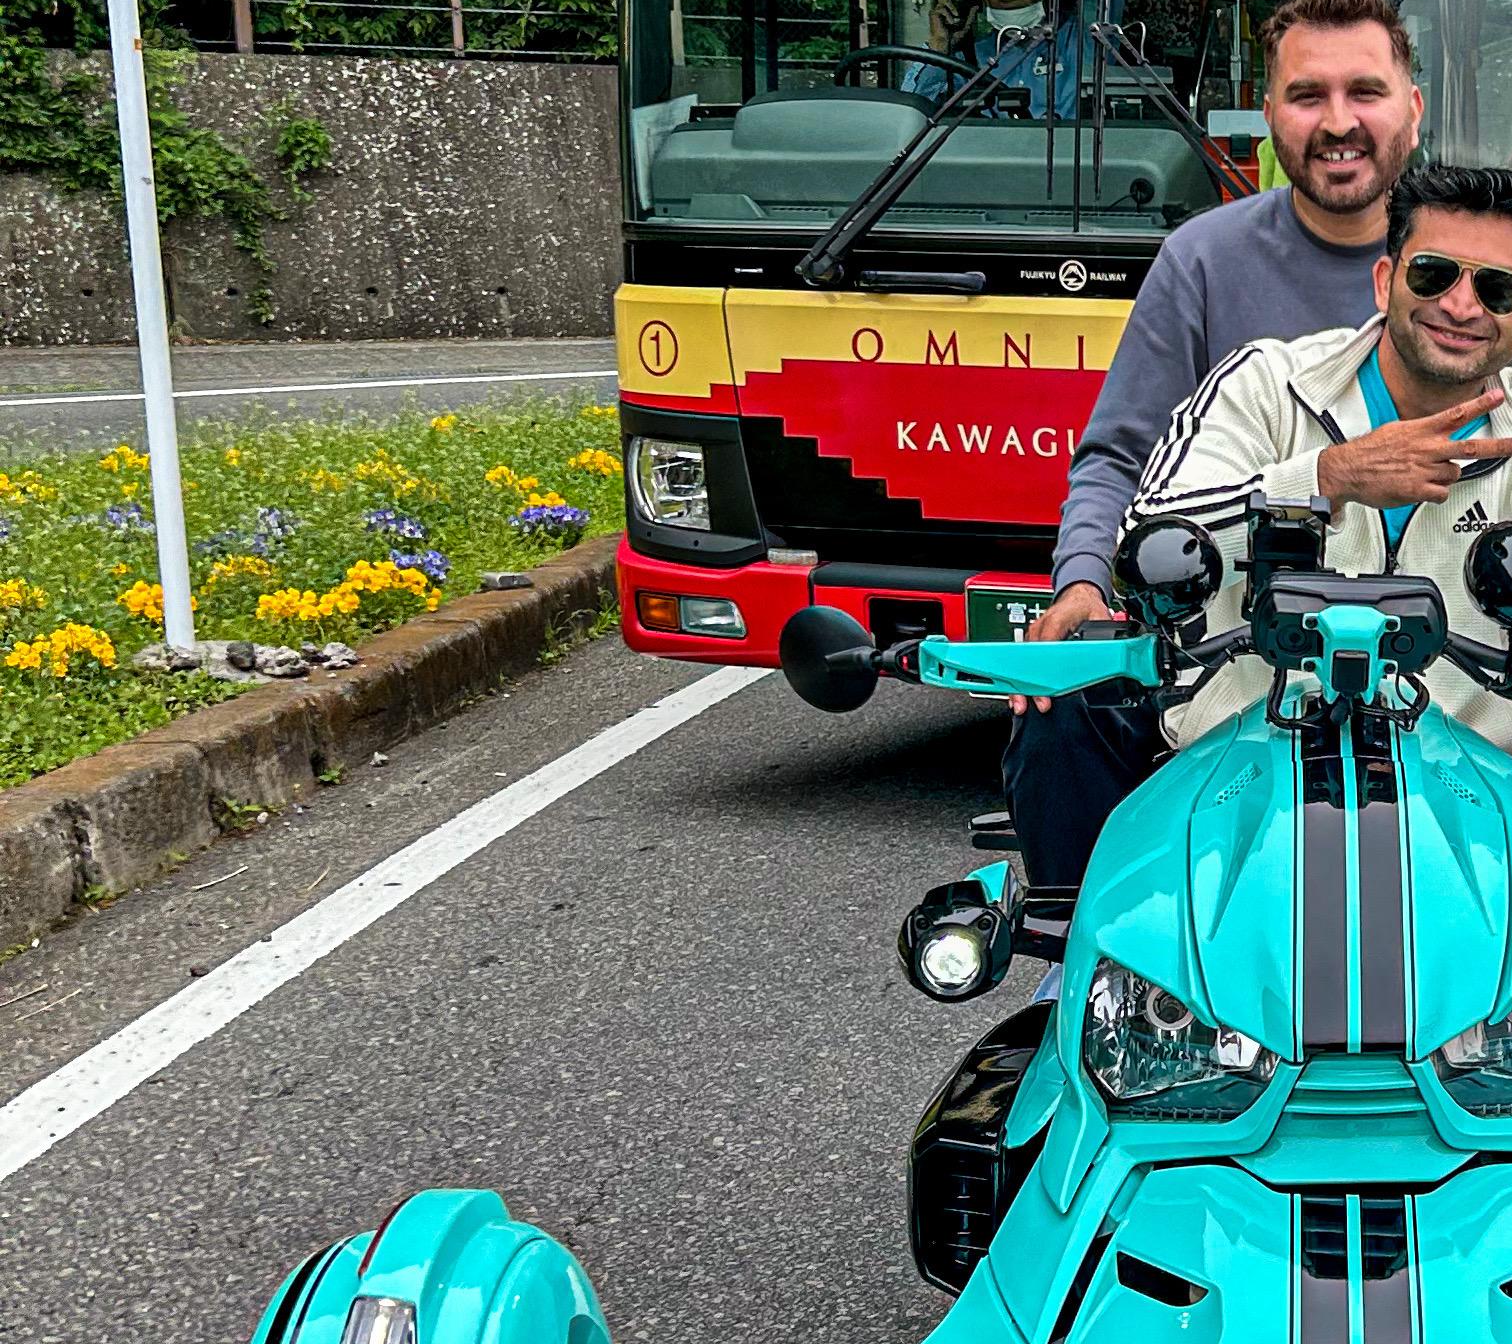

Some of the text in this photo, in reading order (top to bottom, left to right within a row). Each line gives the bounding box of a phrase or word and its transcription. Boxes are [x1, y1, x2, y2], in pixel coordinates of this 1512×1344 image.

[1020, 269, 1128, 283] FUJIKYU RAILWAY
[1452, 520, 1496, 534] adida
